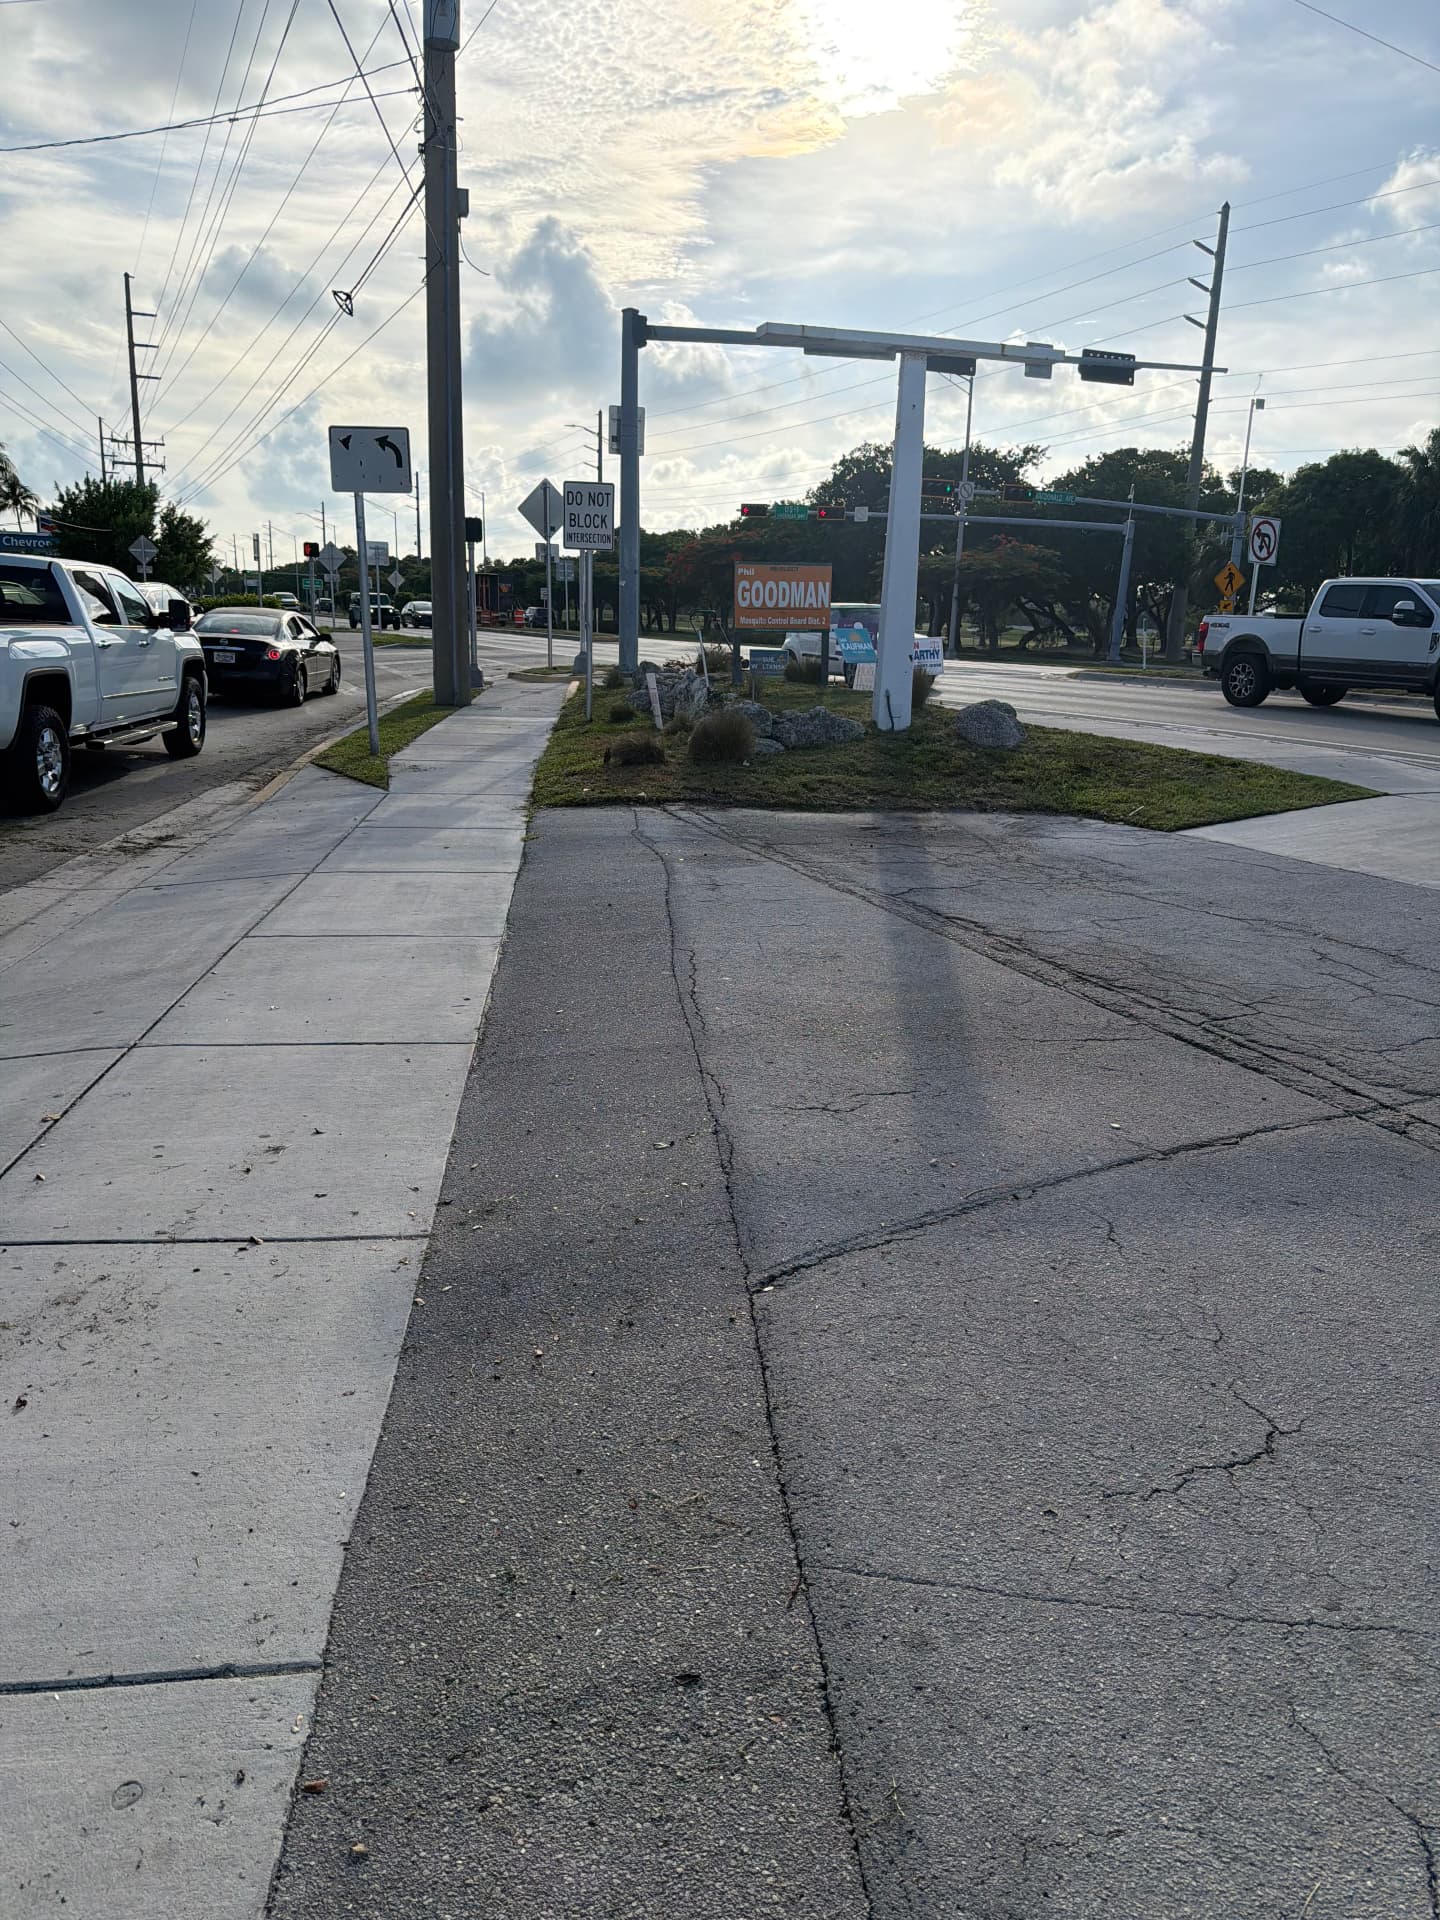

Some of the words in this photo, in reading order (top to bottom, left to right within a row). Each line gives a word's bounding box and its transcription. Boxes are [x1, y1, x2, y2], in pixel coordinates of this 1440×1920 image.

[567, 491, 583, 506] DO
[588, 492, 611, 507] NOT
[569, 513, 608, 529] BLOCK
[566, 532, 611, 544] INTERSECTION
[737, 568, 755, 576] Phil
[737, 580, 830, 608] GOODMAN
[740, 616, 767, 626] Mosquito
[768, 616, 788, 625] Control
[790, 617, 807, 625] Board
[808, 617, 821, 625] Dist.
[822, 617, 826, 625] 2
[914, 649, 940, 660] ARTHY
